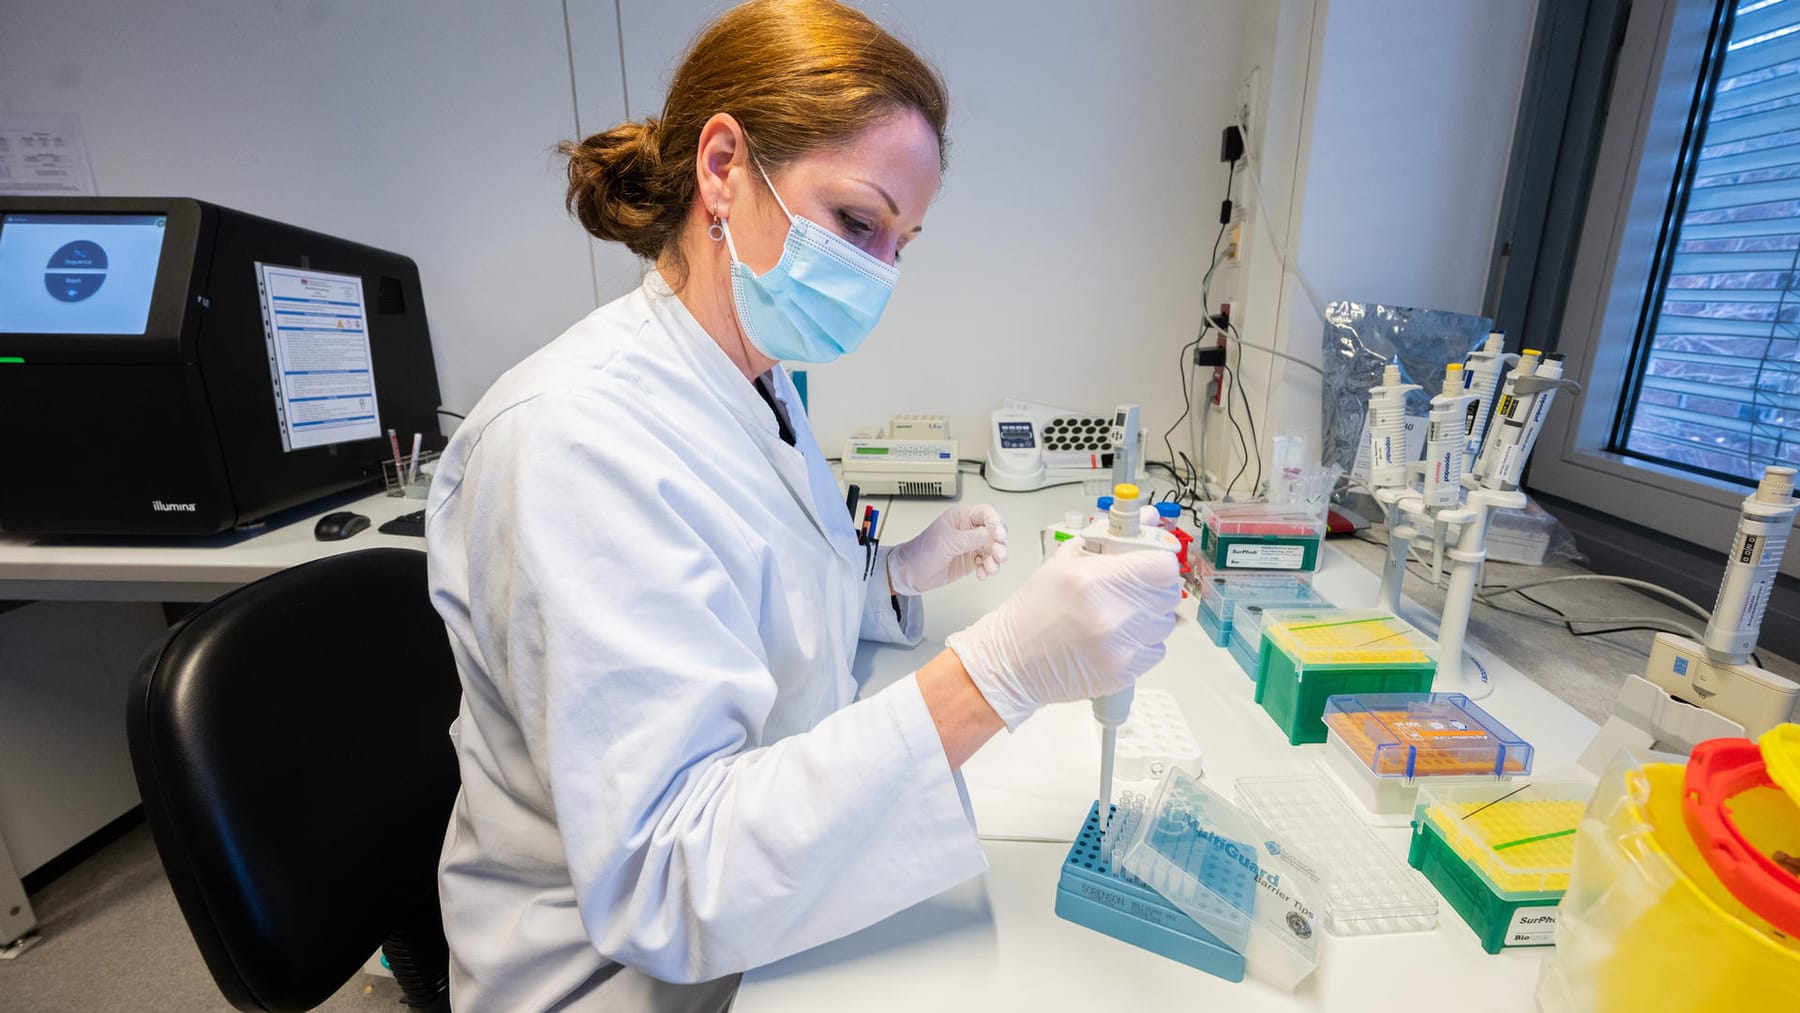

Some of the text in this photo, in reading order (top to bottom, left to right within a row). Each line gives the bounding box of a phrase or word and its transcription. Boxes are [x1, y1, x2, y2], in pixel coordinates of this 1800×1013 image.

[152, 500, 196, 512] illumina
[1183, 812, 1280, 887] MultiGuard
[1253, 874, 1314, 921] Barrier Tips
